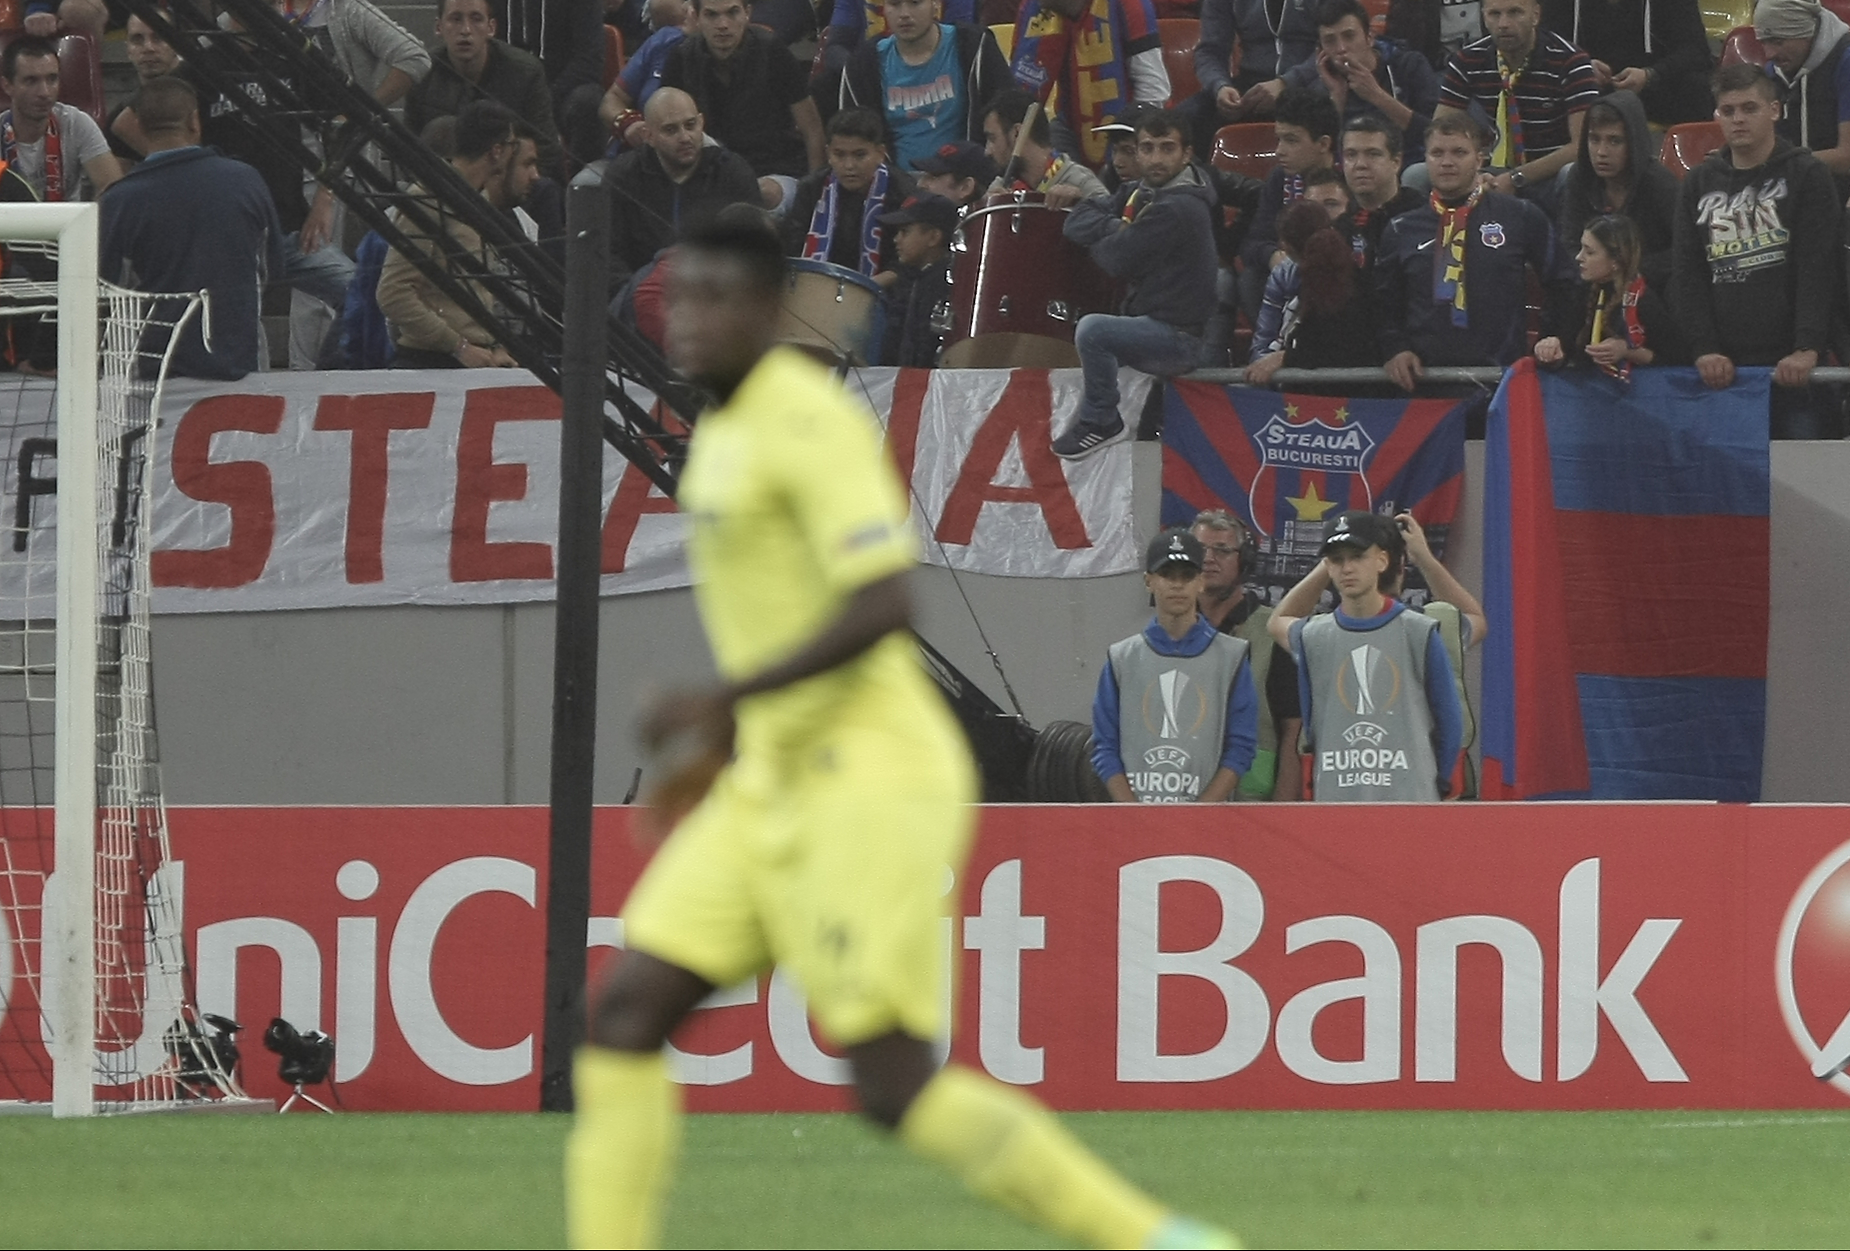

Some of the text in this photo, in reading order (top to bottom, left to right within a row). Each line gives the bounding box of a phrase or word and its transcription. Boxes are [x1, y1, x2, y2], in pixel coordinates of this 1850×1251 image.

[888, 74, 954, 111] PUMA
[1266, 424, 1361, 451] STEAUA
[1267, 448, 1359, 468] BUCURESTI
[150, 367, 1094, 588] STEA
[1341, 723, 1384, 745] UEFA
[1144, 748, 1187, 768] UEFA
[1321, 748, 1409, 772] EUROPA
[1337, 771, 1392, 788] LEAGUE
[1116, 854, 1691, 1086] Bank
